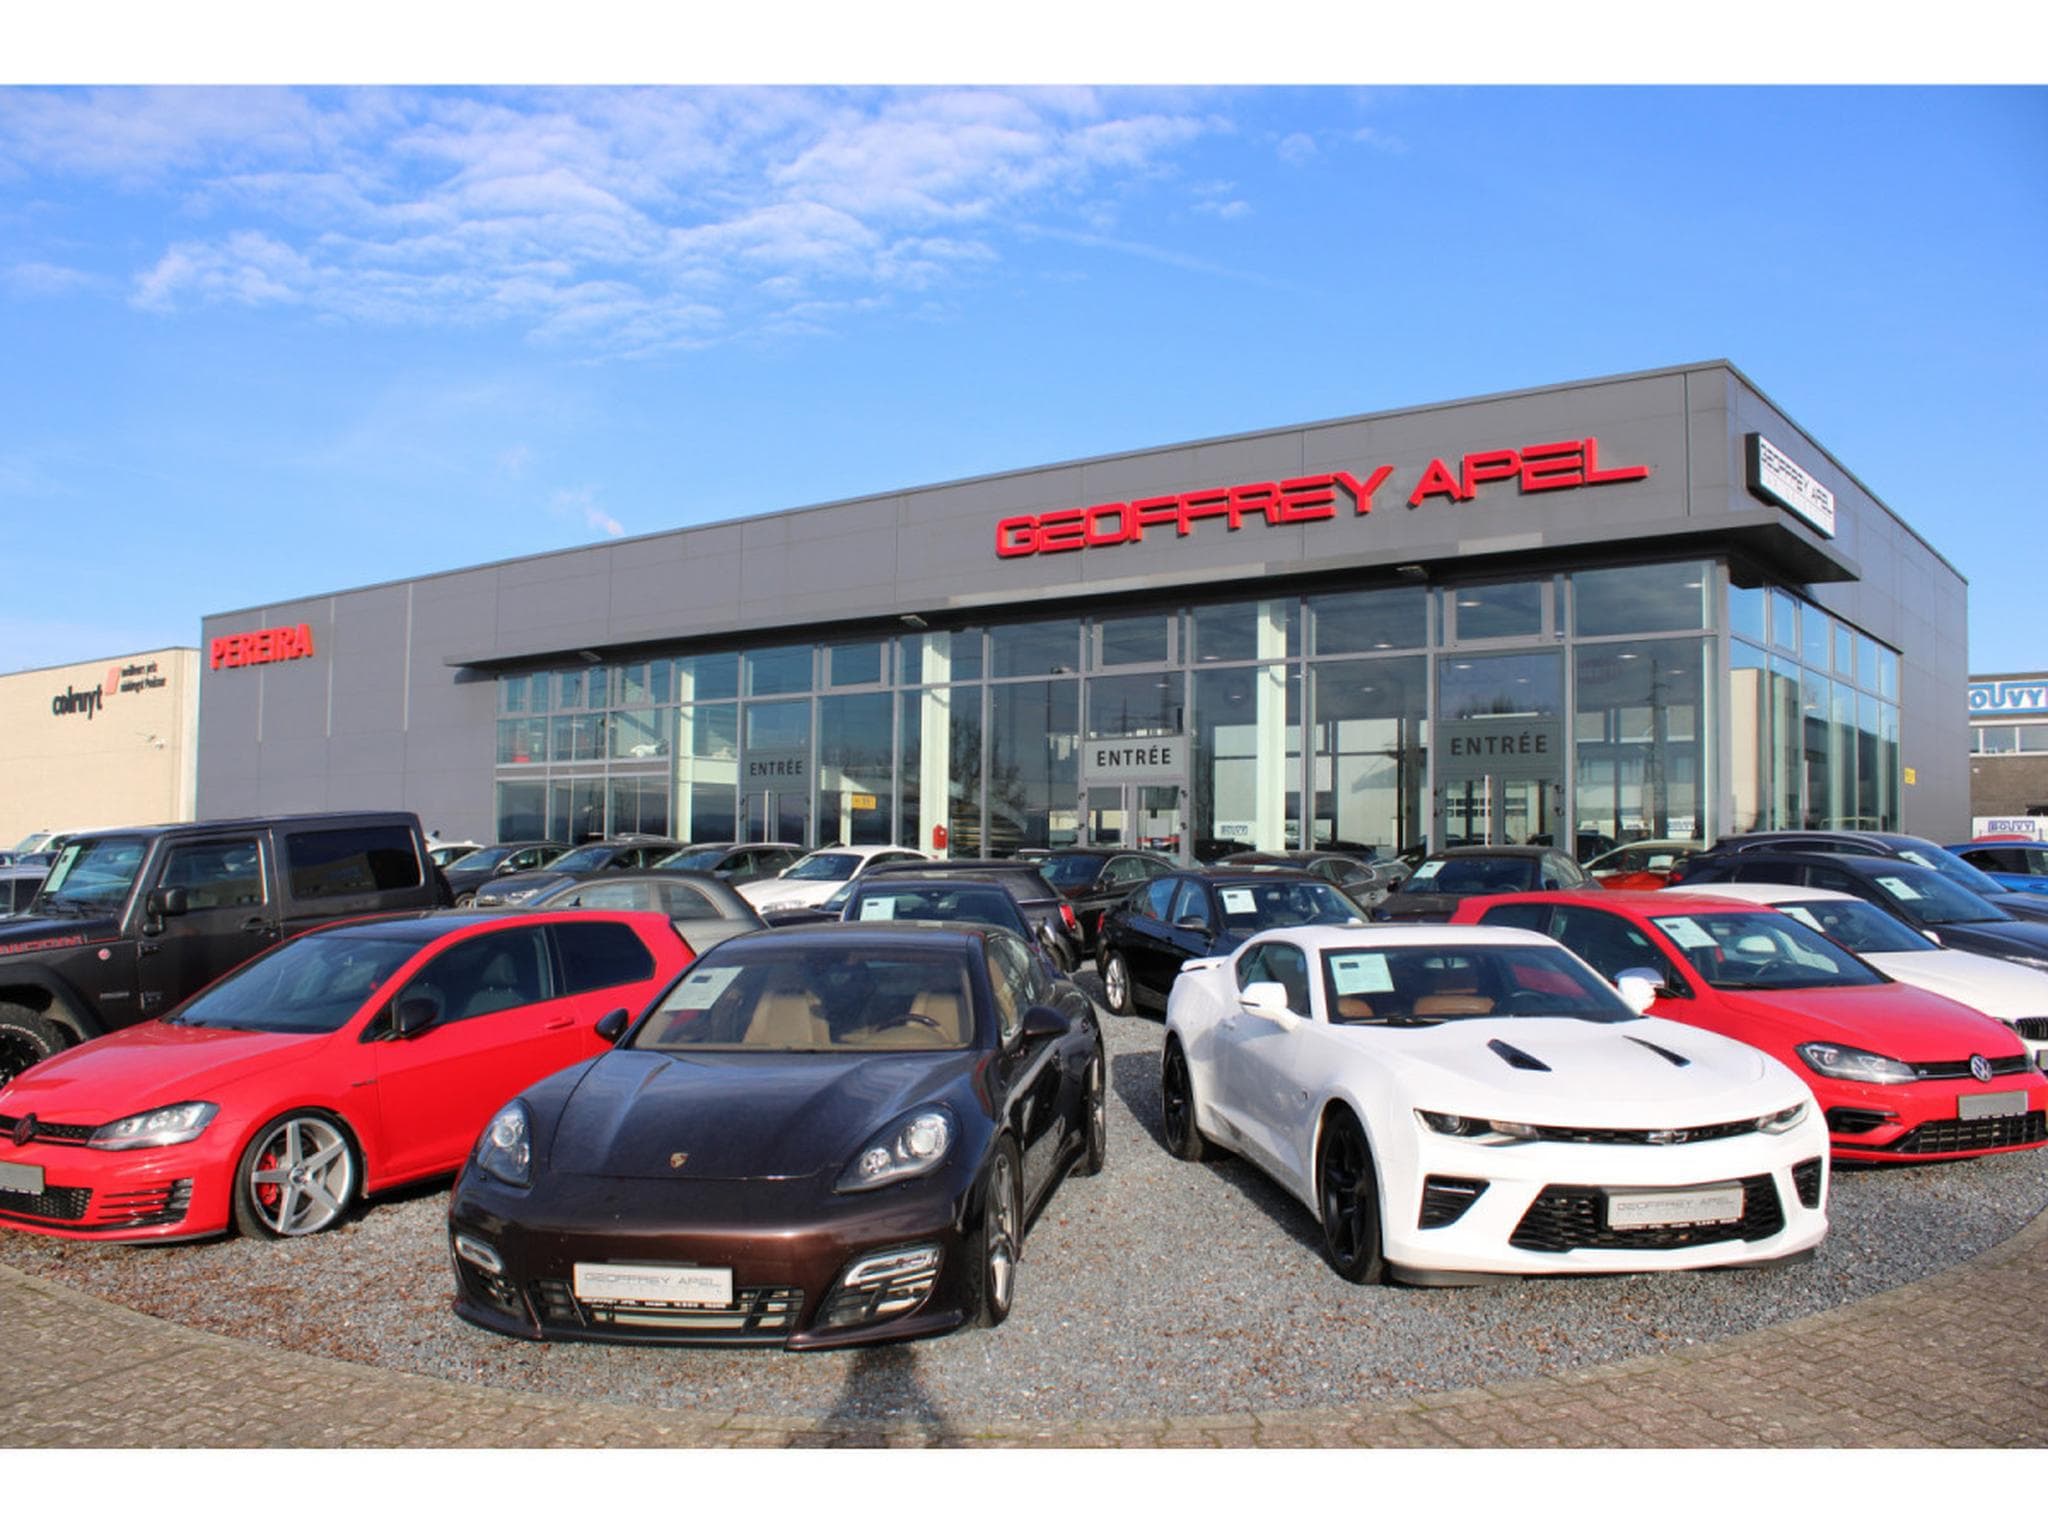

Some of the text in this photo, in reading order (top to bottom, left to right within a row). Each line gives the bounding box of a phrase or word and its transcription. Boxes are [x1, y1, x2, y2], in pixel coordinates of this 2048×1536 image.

[995, 437, 1650, 559] GEOFFREY APEL
[210, 623, 314, 671] PEREIRA
[52, 683, 103, 721] colruyt
[1969, 684, 2043, 709] OUVY
[1097, 745, 1172, 767] ENTRÉE
[1451, 731, 1548, 756] ENTRÉE
[750, 758, 803, 777] ENTRÉE
[1988, 820, 2035, 833] BOUVY
